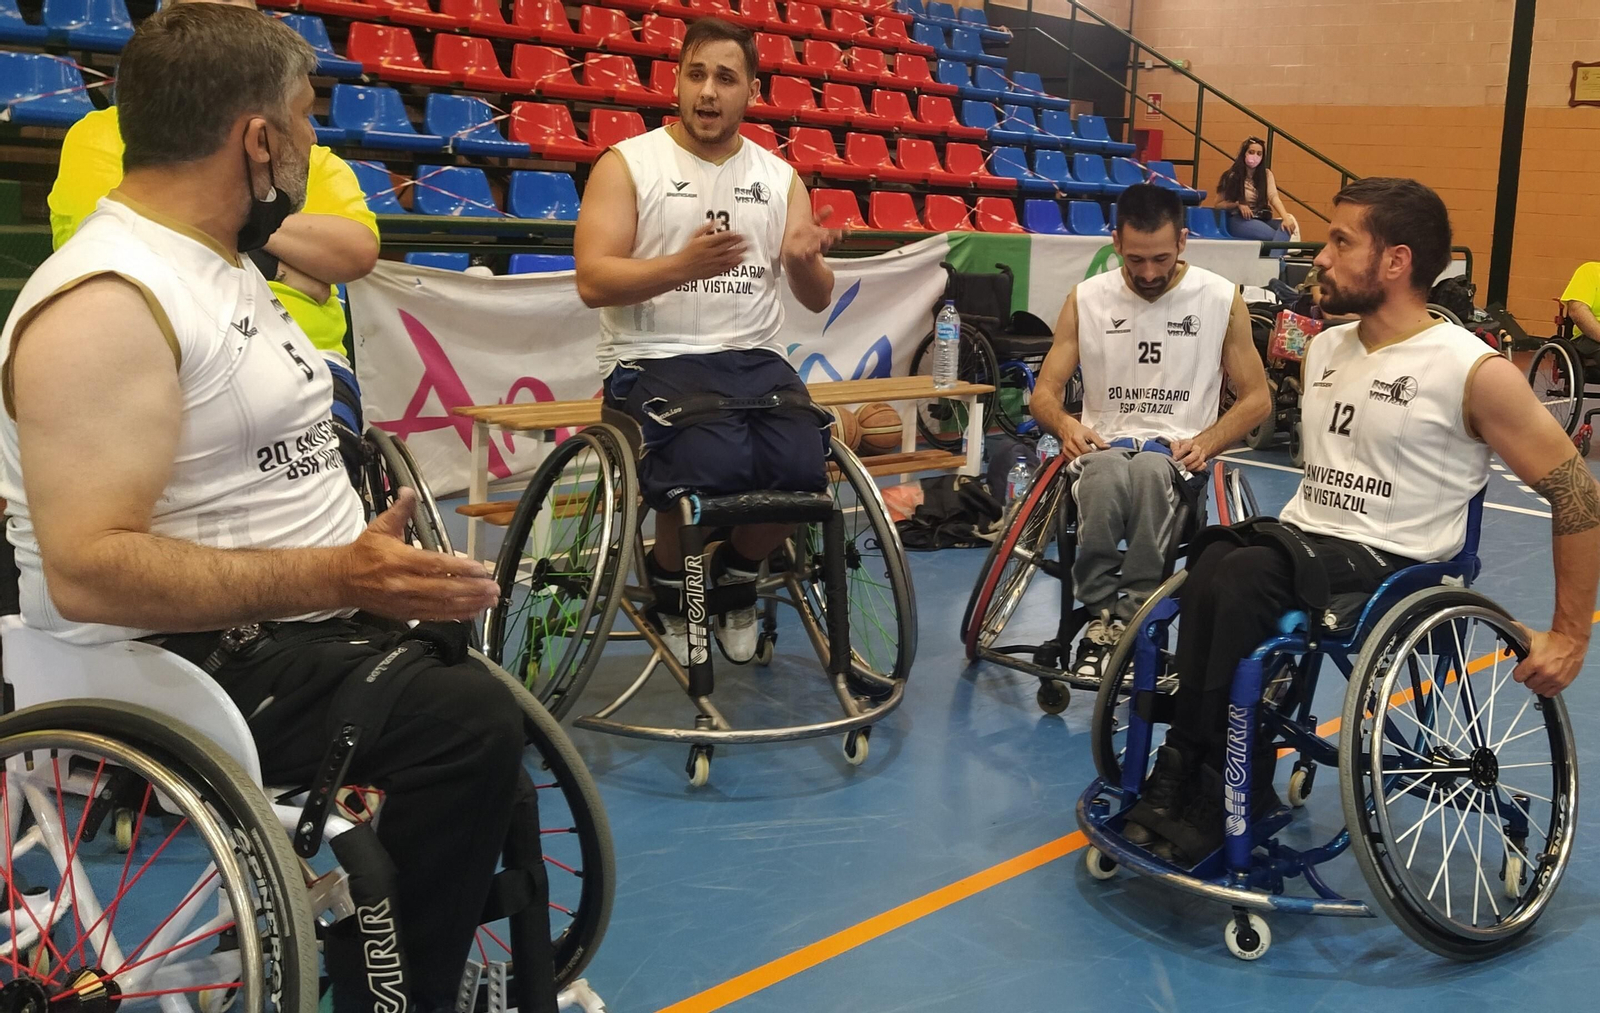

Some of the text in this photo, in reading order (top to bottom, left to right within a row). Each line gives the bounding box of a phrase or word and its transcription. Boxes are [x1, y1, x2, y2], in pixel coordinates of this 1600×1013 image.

[705, 209, 730, 236] 23
[702, 280, 754, 295] VISTAZUL
[281, 341, 315, 383] 5
[1138, 341, 1162, 364] 25
[1108, 386, 1122, 400] 20
[1328, 401, 1355, 437] 12
[257, 440, 292, 473] 20
[1306, 464, 1392, 498] ANIVERSARIO
[1314, 487, 1368, 515] VISTAZUL
